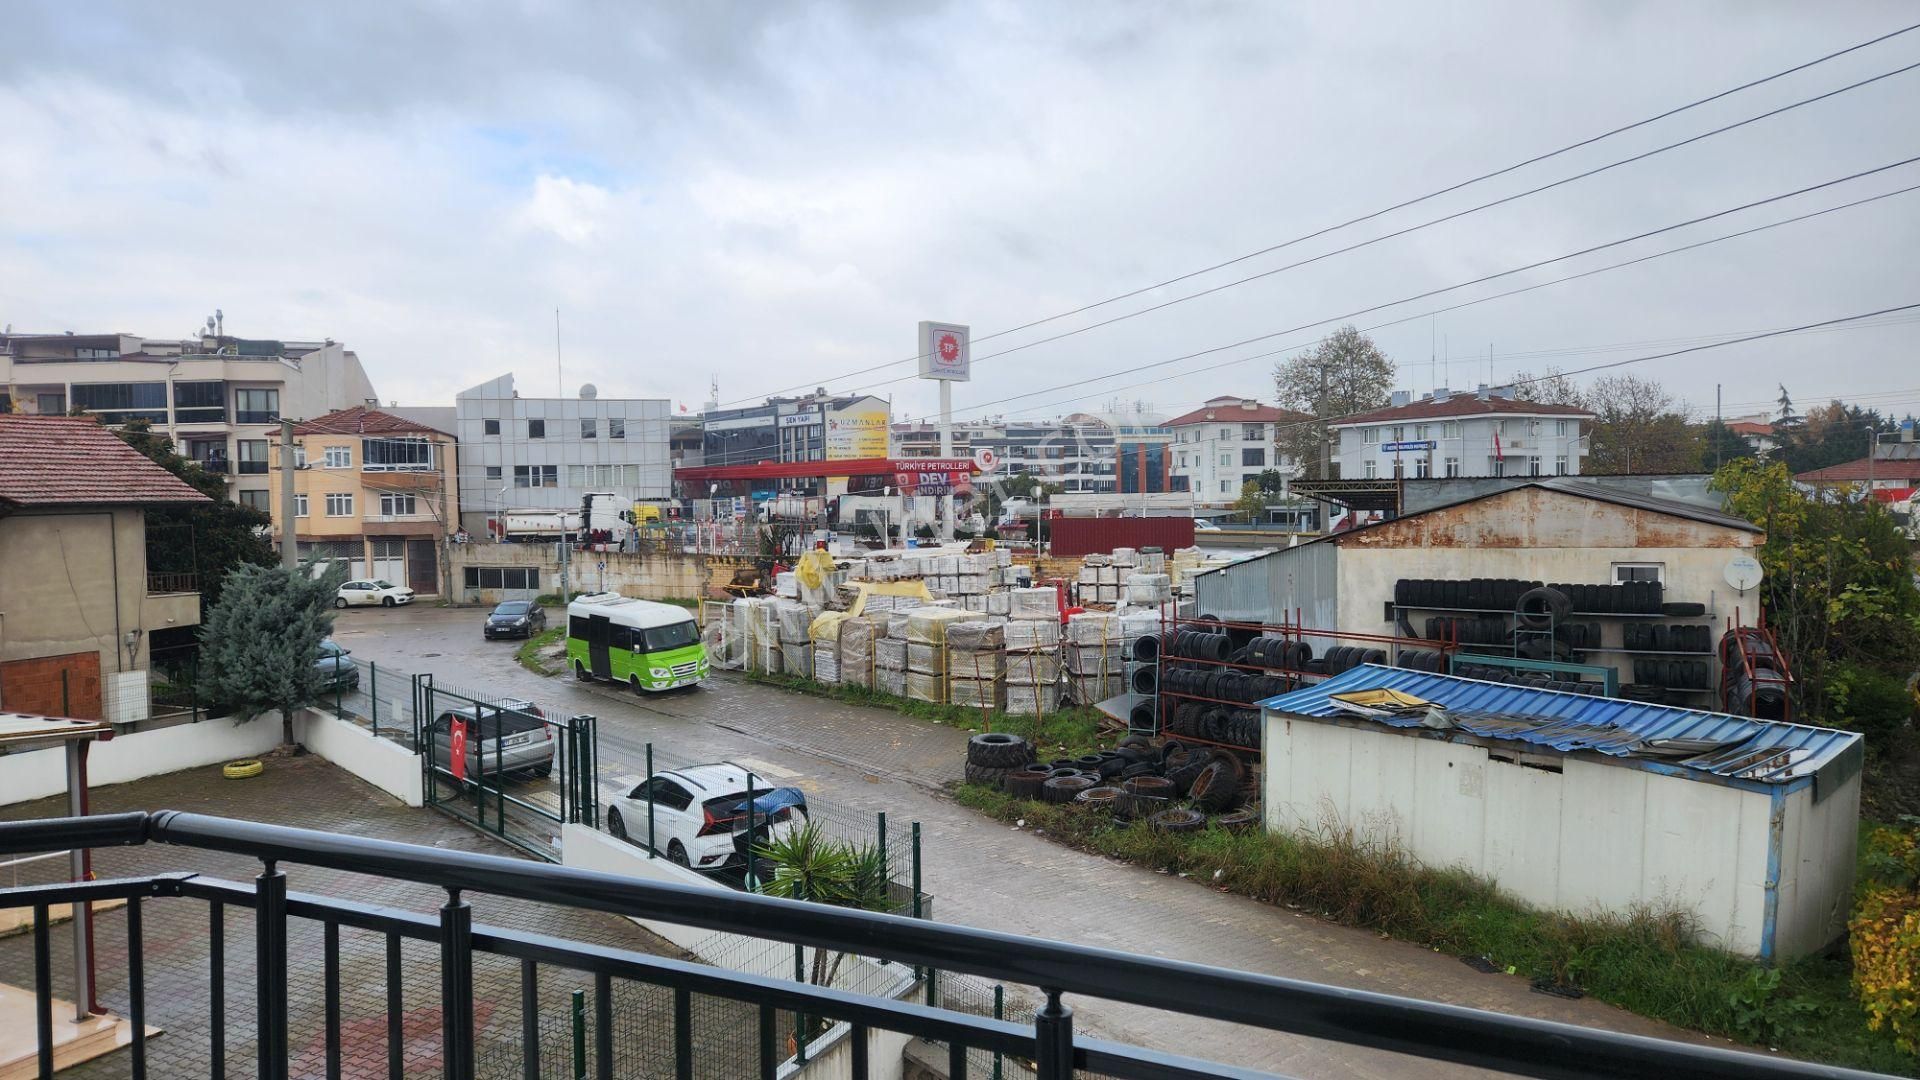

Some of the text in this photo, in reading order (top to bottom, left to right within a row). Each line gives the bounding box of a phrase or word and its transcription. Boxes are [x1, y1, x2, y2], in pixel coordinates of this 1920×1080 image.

[840, 418, 886, 426] UZMANLAR
[895, 461, 970, 471] TÜRKİYE PETROLLERİ
[919, 473, 947, 485] DEV
